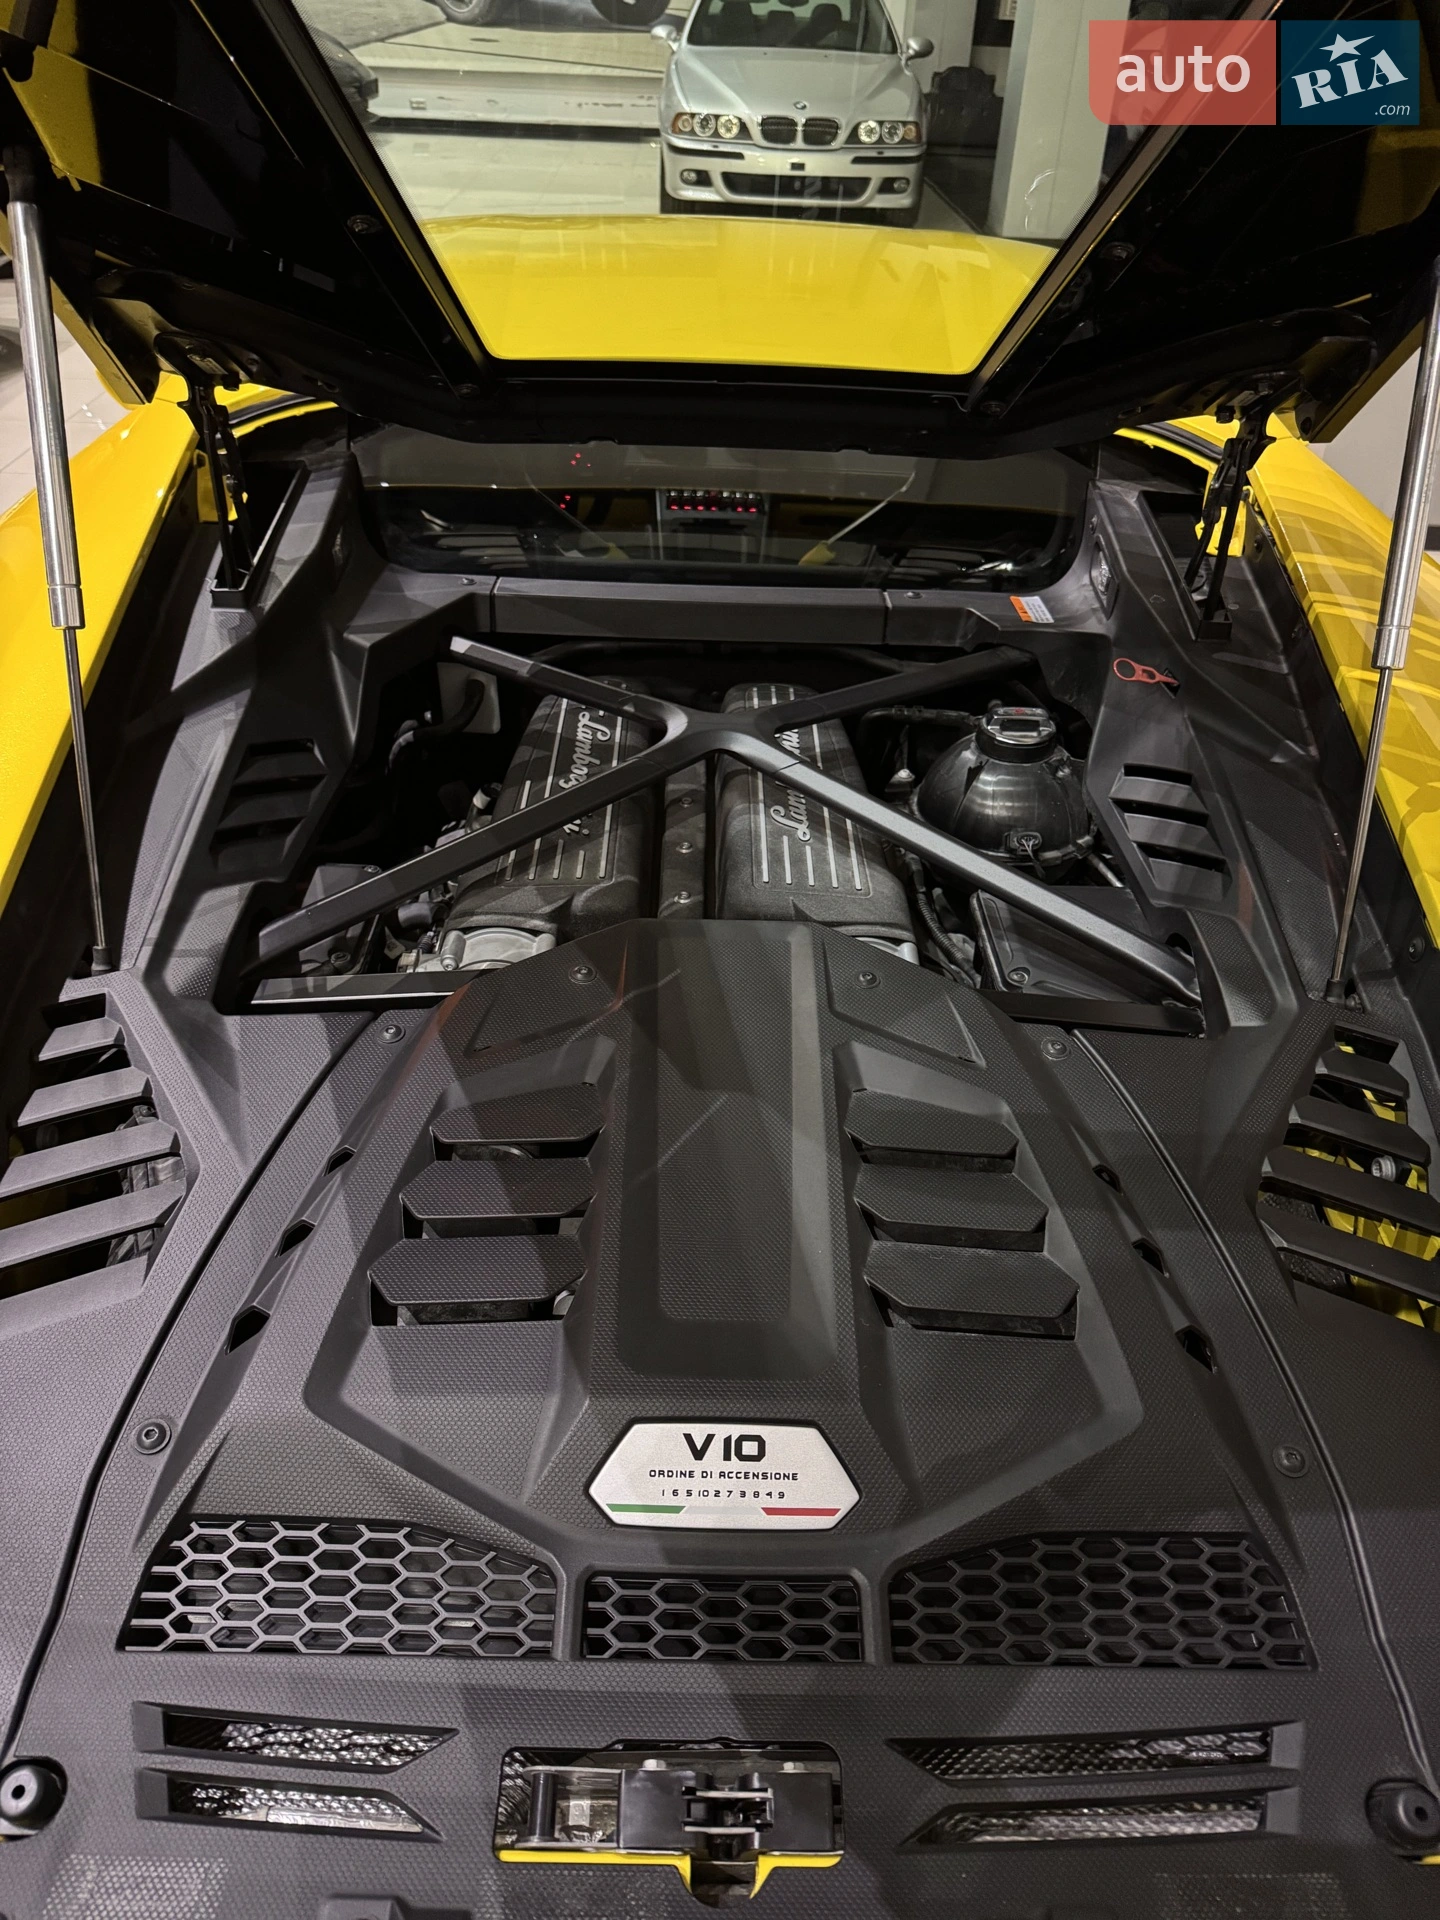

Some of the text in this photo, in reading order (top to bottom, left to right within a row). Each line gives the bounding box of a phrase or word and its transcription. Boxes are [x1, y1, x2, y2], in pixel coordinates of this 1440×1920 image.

[683, 1432, 766, 1463] V10
[649, 1469, 799, 1481] ORDINE DI ACCENSIONE
